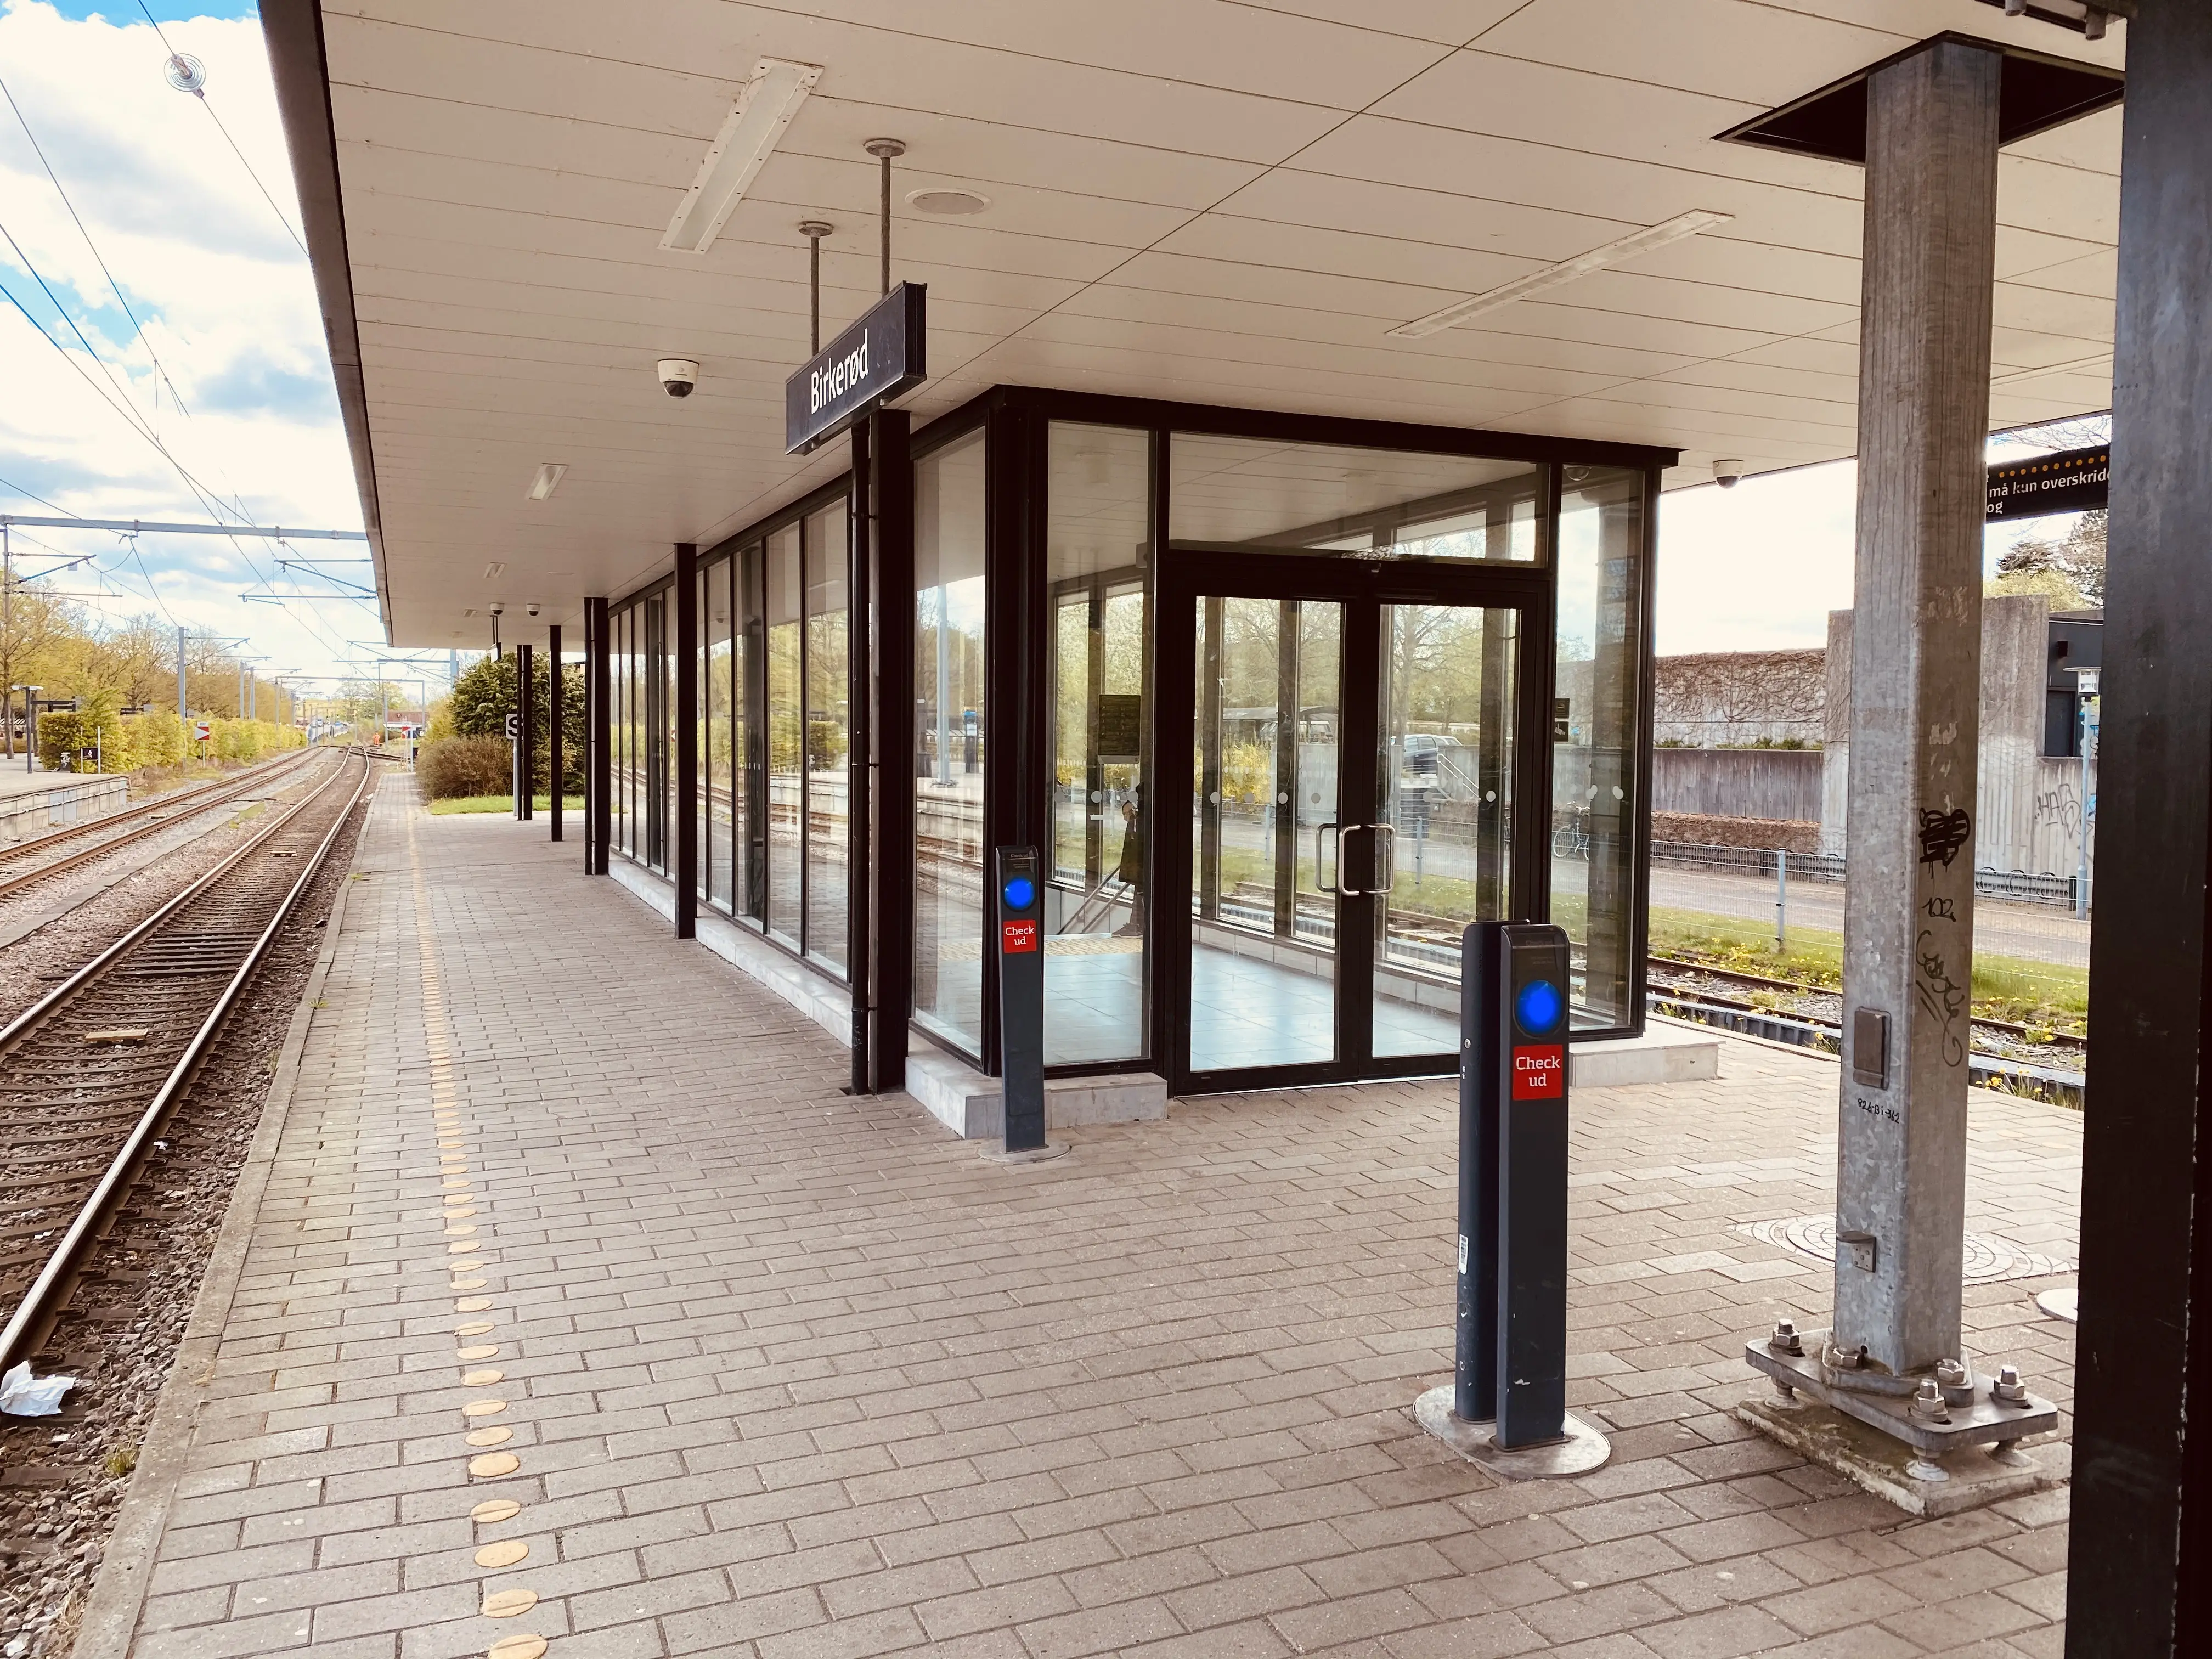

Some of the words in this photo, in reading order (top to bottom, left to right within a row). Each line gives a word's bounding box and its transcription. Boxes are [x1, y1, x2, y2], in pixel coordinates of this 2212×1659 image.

[811, 328, 869, 414] Birkerød
[1989, 482, 2008, 498] må
[1005, 925, 1035, 936] Check
[1014, 936, 1026, 945] ud
[1516, 1055, 1560, 1070] Check
[1528, 1073, 1547, 1087] ud
